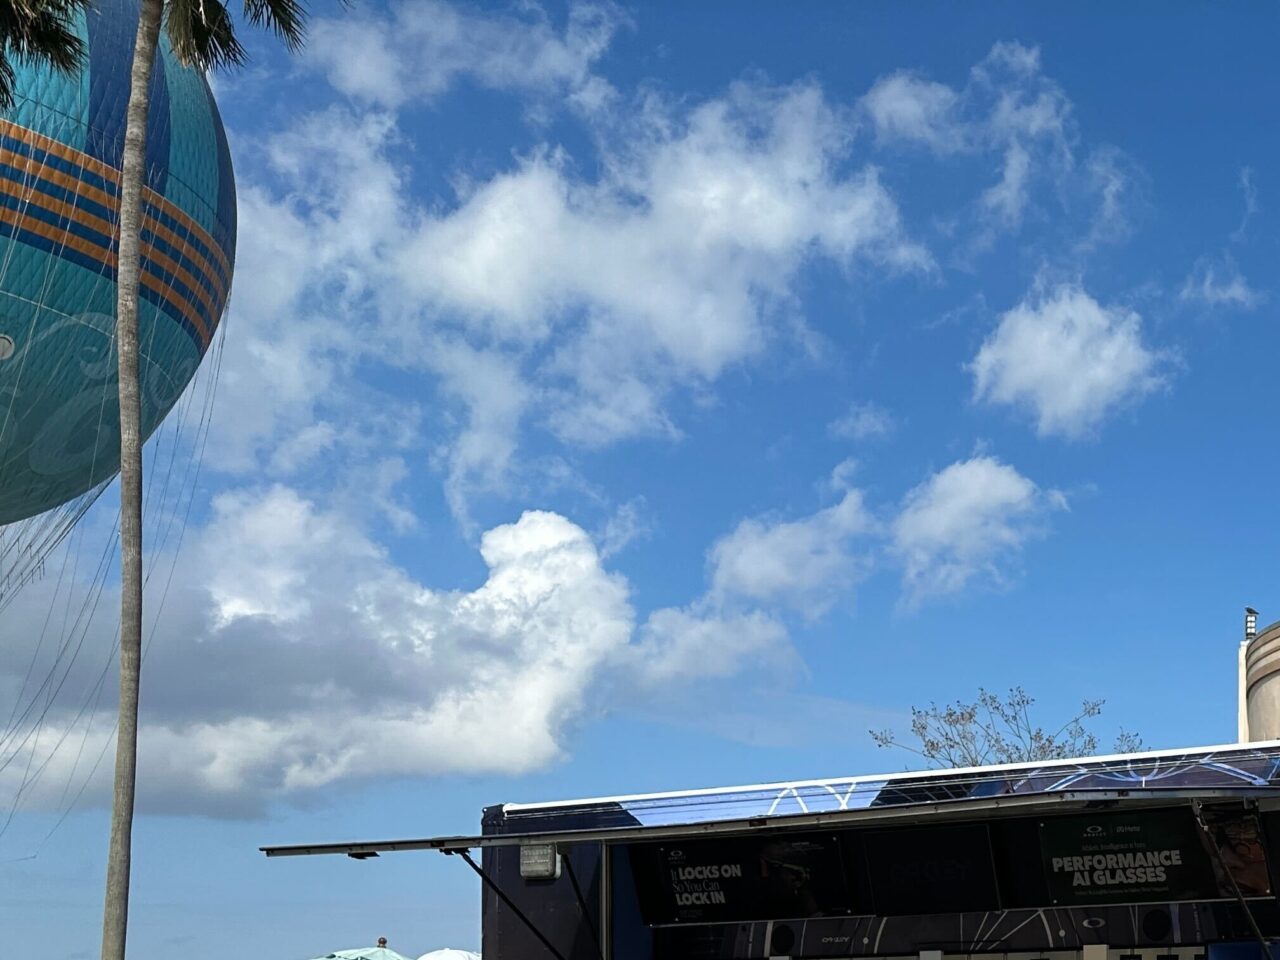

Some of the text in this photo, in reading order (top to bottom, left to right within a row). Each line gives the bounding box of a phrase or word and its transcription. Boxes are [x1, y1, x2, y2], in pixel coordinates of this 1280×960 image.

[1051, 849, 1183, 873] PERFORMANCE
[679, 865, 720, 880] LOCKS
[720, 863, 743, 879] ON
[1072, 866, 1168, 887] AI GLASSES
[672, 880, 720, 894] So You Can
[675, 890, 727, 907] LOCK IN
